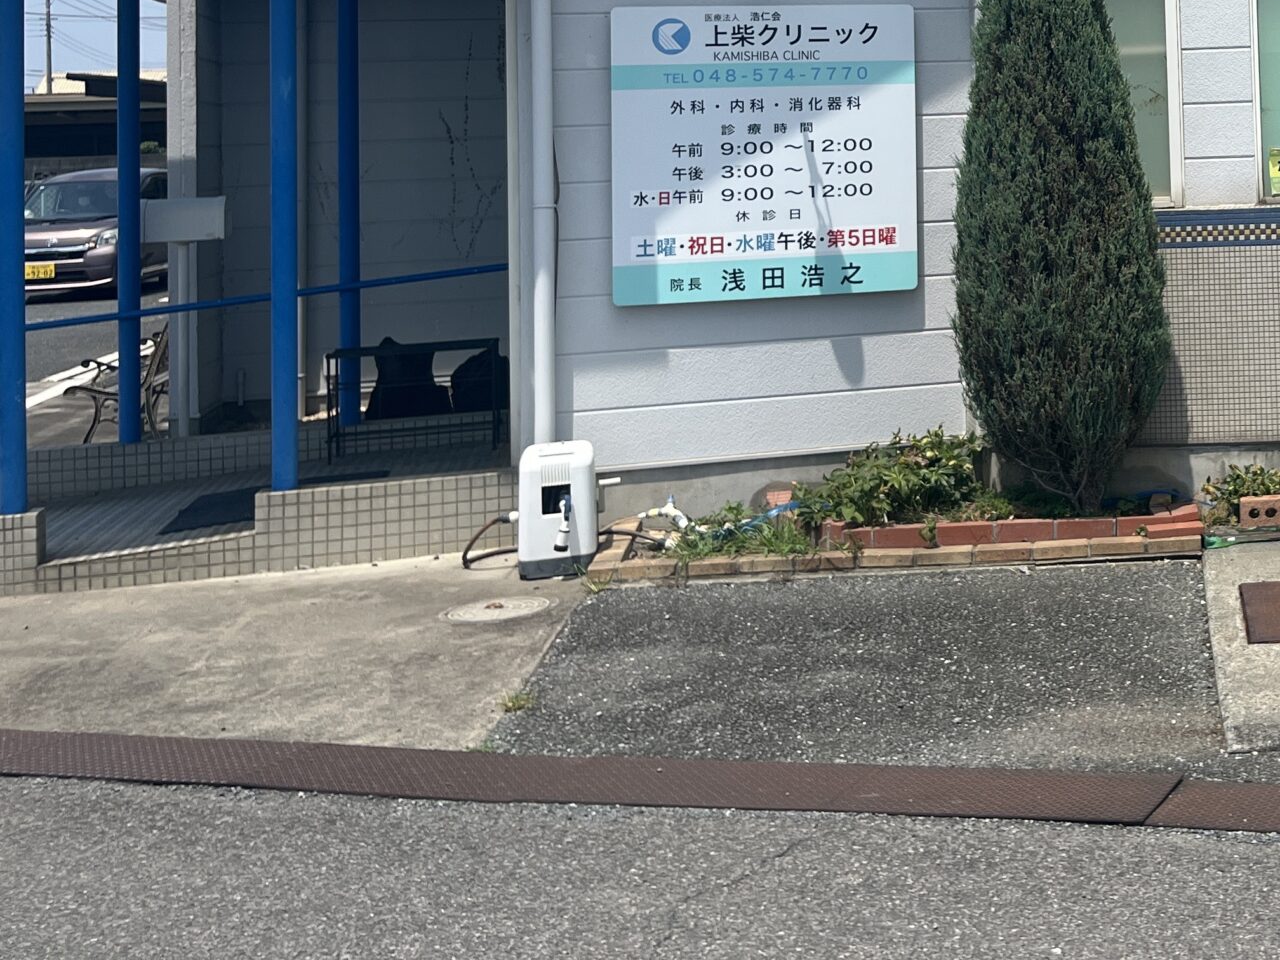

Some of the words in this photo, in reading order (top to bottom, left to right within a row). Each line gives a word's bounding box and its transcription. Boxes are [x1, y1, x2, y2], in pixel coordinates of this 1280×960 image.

[704, 13, 740, 22] 医療法人
[750, 11, 781, 22] 浩仁会
[705, 22, 879, 47] 上柴クリニック
[714, 51, 779, 61] KAMISHIBA
[783, 50, 820, 60] CLINIC
[664, 72, 688, 83] TEL
[693, 66, 868, 83] 048-574-7770
[670, 96, 861, 115] 外科・内科・消化器科
[721, 122, 813, 135] 診療時間
[672, 143, 703, 157] 午前
[672, 166, 703, 181] 午後
[736, 209, 801, 222] 休診日
[670, 278, 702, 292] 院長
[721, 263, 863, 292] 浅田浩之
